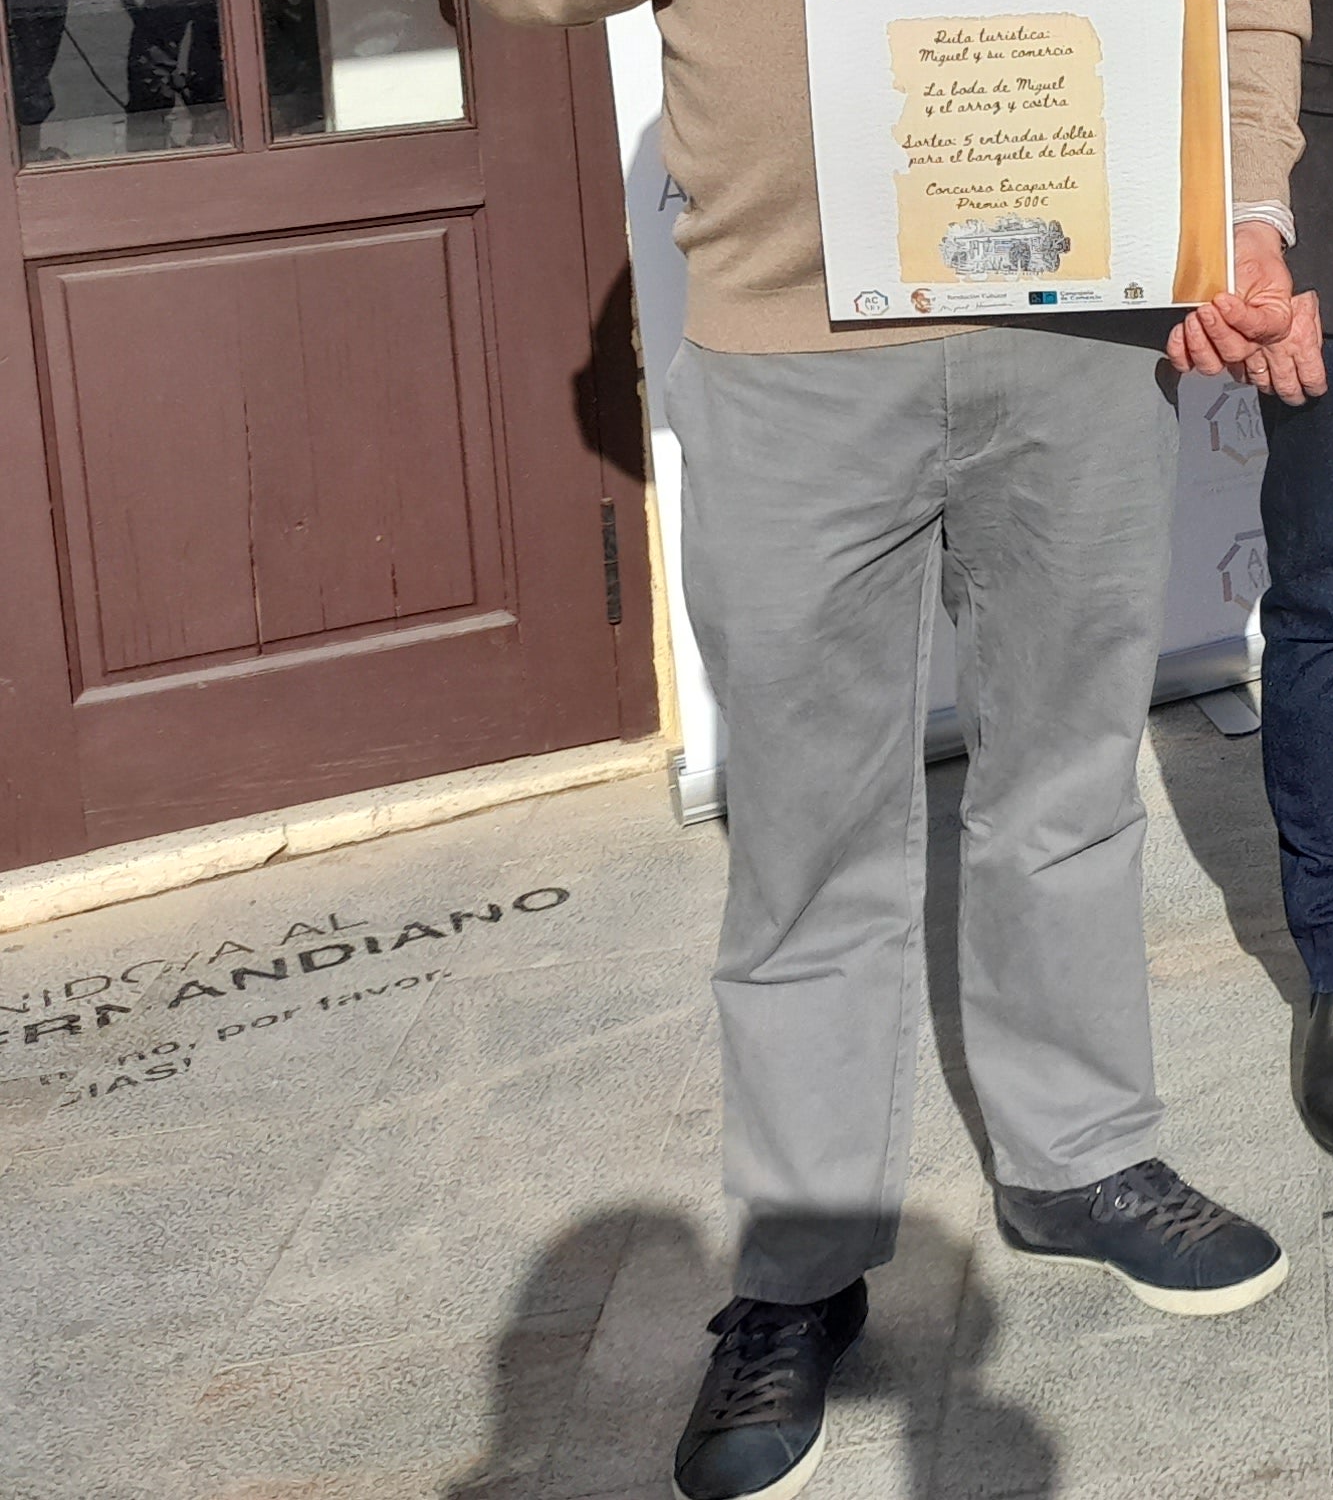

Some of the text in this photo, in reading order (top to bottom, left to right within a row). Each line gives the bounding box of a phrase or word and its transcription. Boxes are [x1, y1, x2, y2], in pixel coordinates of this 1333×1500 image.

[933, 29, 972, 45] Ruta
[918, 46, 1074, 67] Miguel y su comercio
[923, 75, 1065, 97] La boda de Miguel
[925, 93, 1068, 118] y el arroz y costra
[963, 133, 974, 147] 5
[979, 128, 1048, 145] entradas
[1052, 124, 1094, 141] dobles
[908, 141, 1096, 168] para el banquete de boda
[925, 175, 1079, 196] Concurso Escaparate
[956, 197, 1009, 210] Premio
[279, 912, 368, 947] AL
[217, 1006, 301, 1041] por
